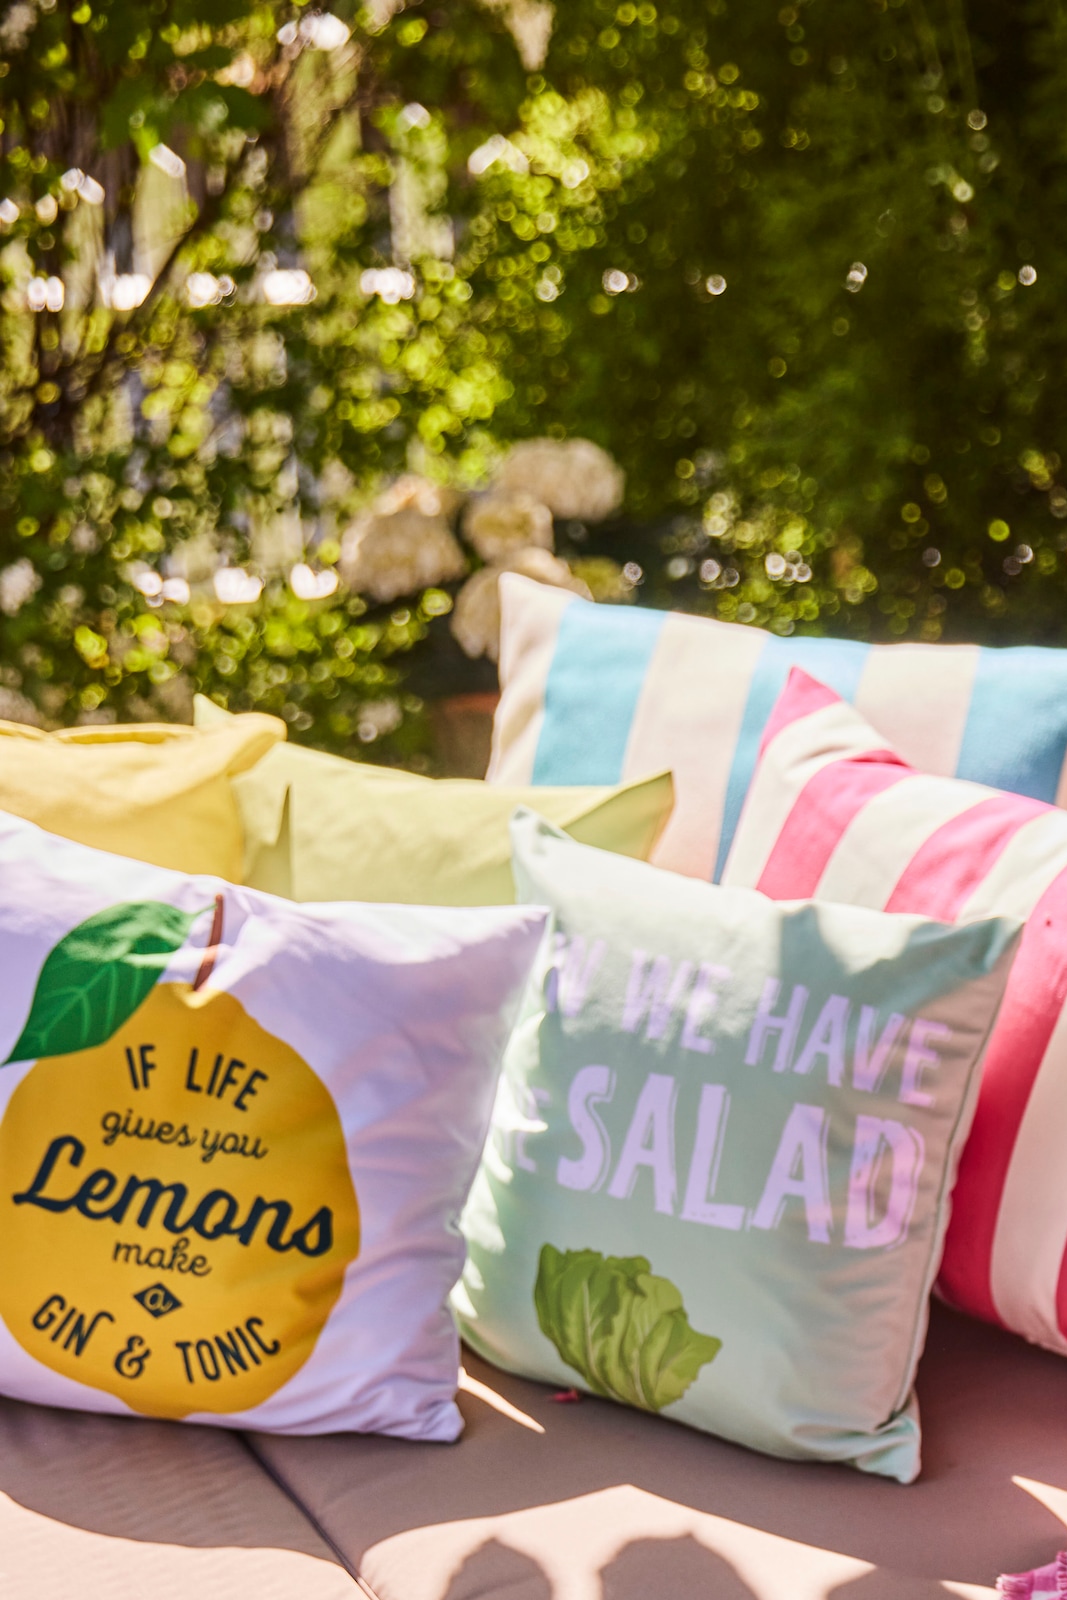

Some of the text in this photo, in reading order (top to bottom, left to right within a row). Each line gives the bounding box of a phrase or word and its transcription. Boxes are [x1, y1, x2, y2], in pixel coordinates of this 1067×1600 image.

[620, 947, 732, 1056] WE
[743, 976, 954, 1109] HAVE
[126, 1044, 269, 1112] IF LIFE
[100, 1108, 268, 1163] gives you
[556, 1064, 926, 1250] SALAD
[12, 1135, 334, 1257] Lemons
[112, 1237, 212, 1277] make
[31, 1294, 281, 1384] GIN & TONIC
